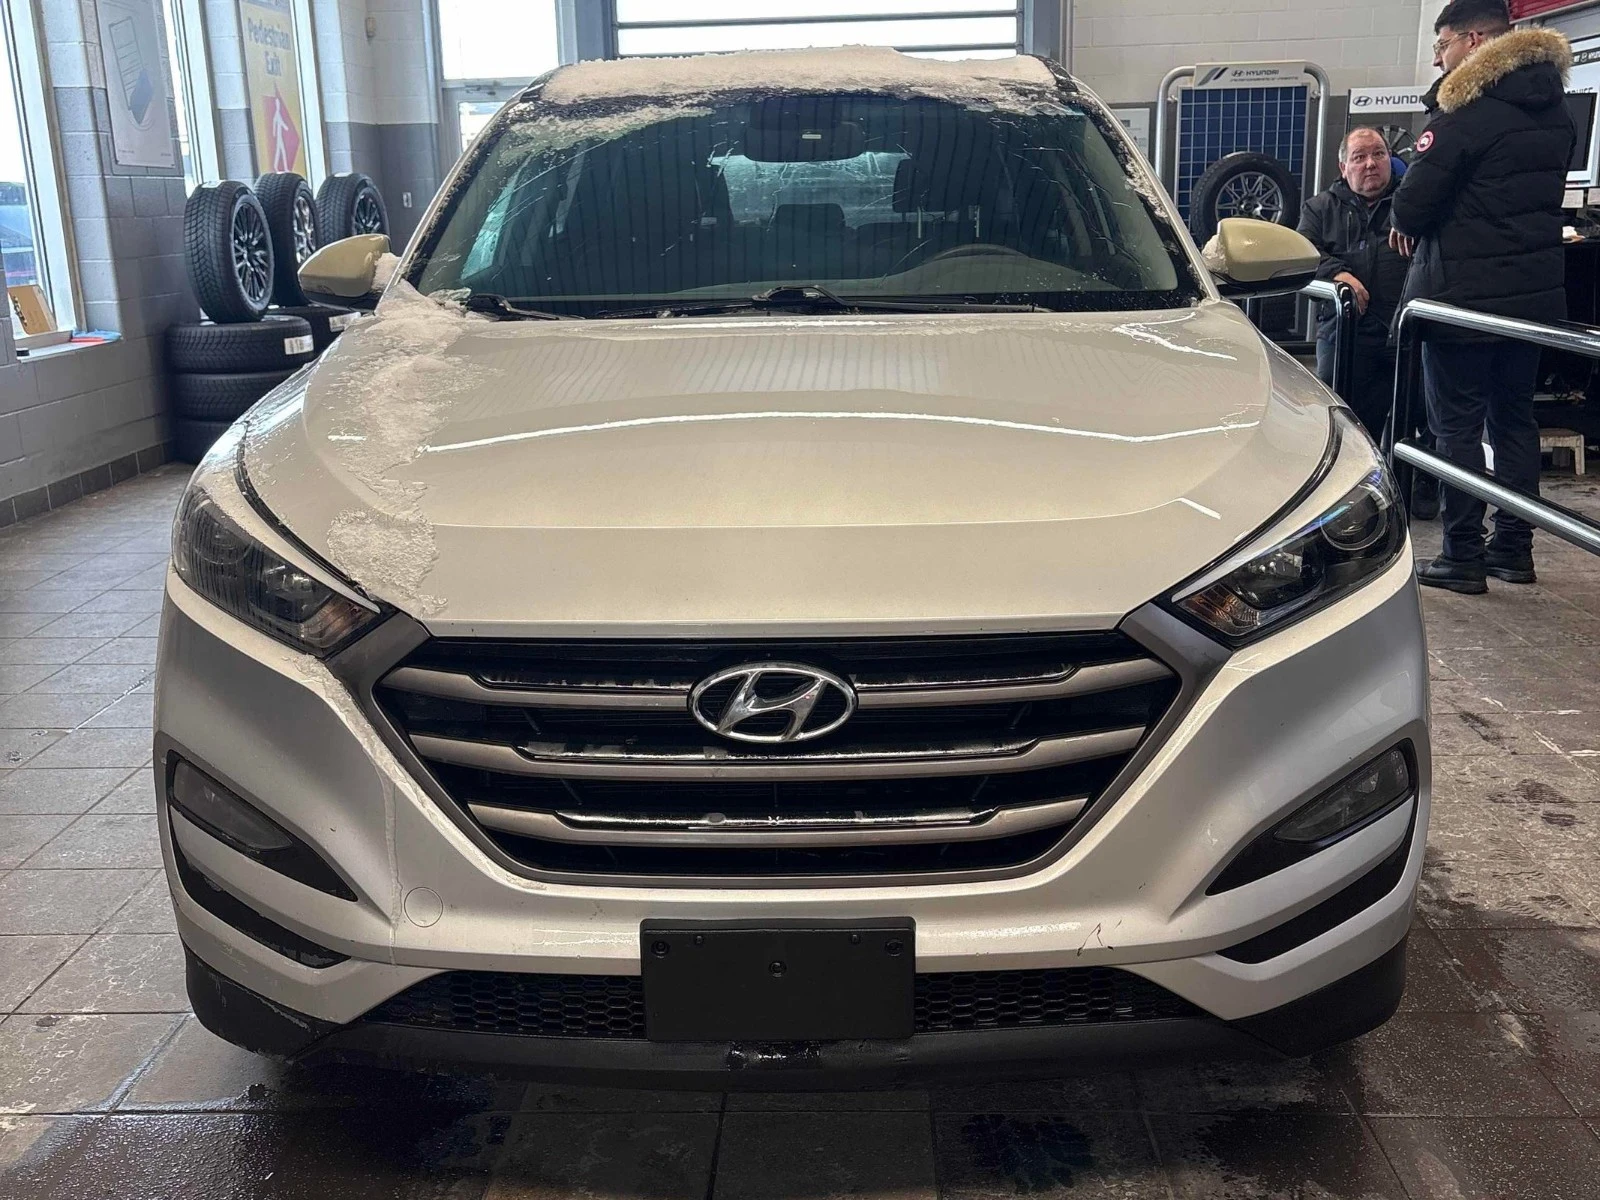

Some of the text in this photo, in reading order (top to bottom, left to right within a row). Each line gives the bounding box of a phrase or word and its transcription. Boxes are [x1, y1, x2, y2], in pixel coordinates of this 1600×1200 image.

[247, 17, 291, 50] Pedestrian
[264, 50, 282, 77] Exit
[1246, 69, 1280, 77] HYUNDAI
